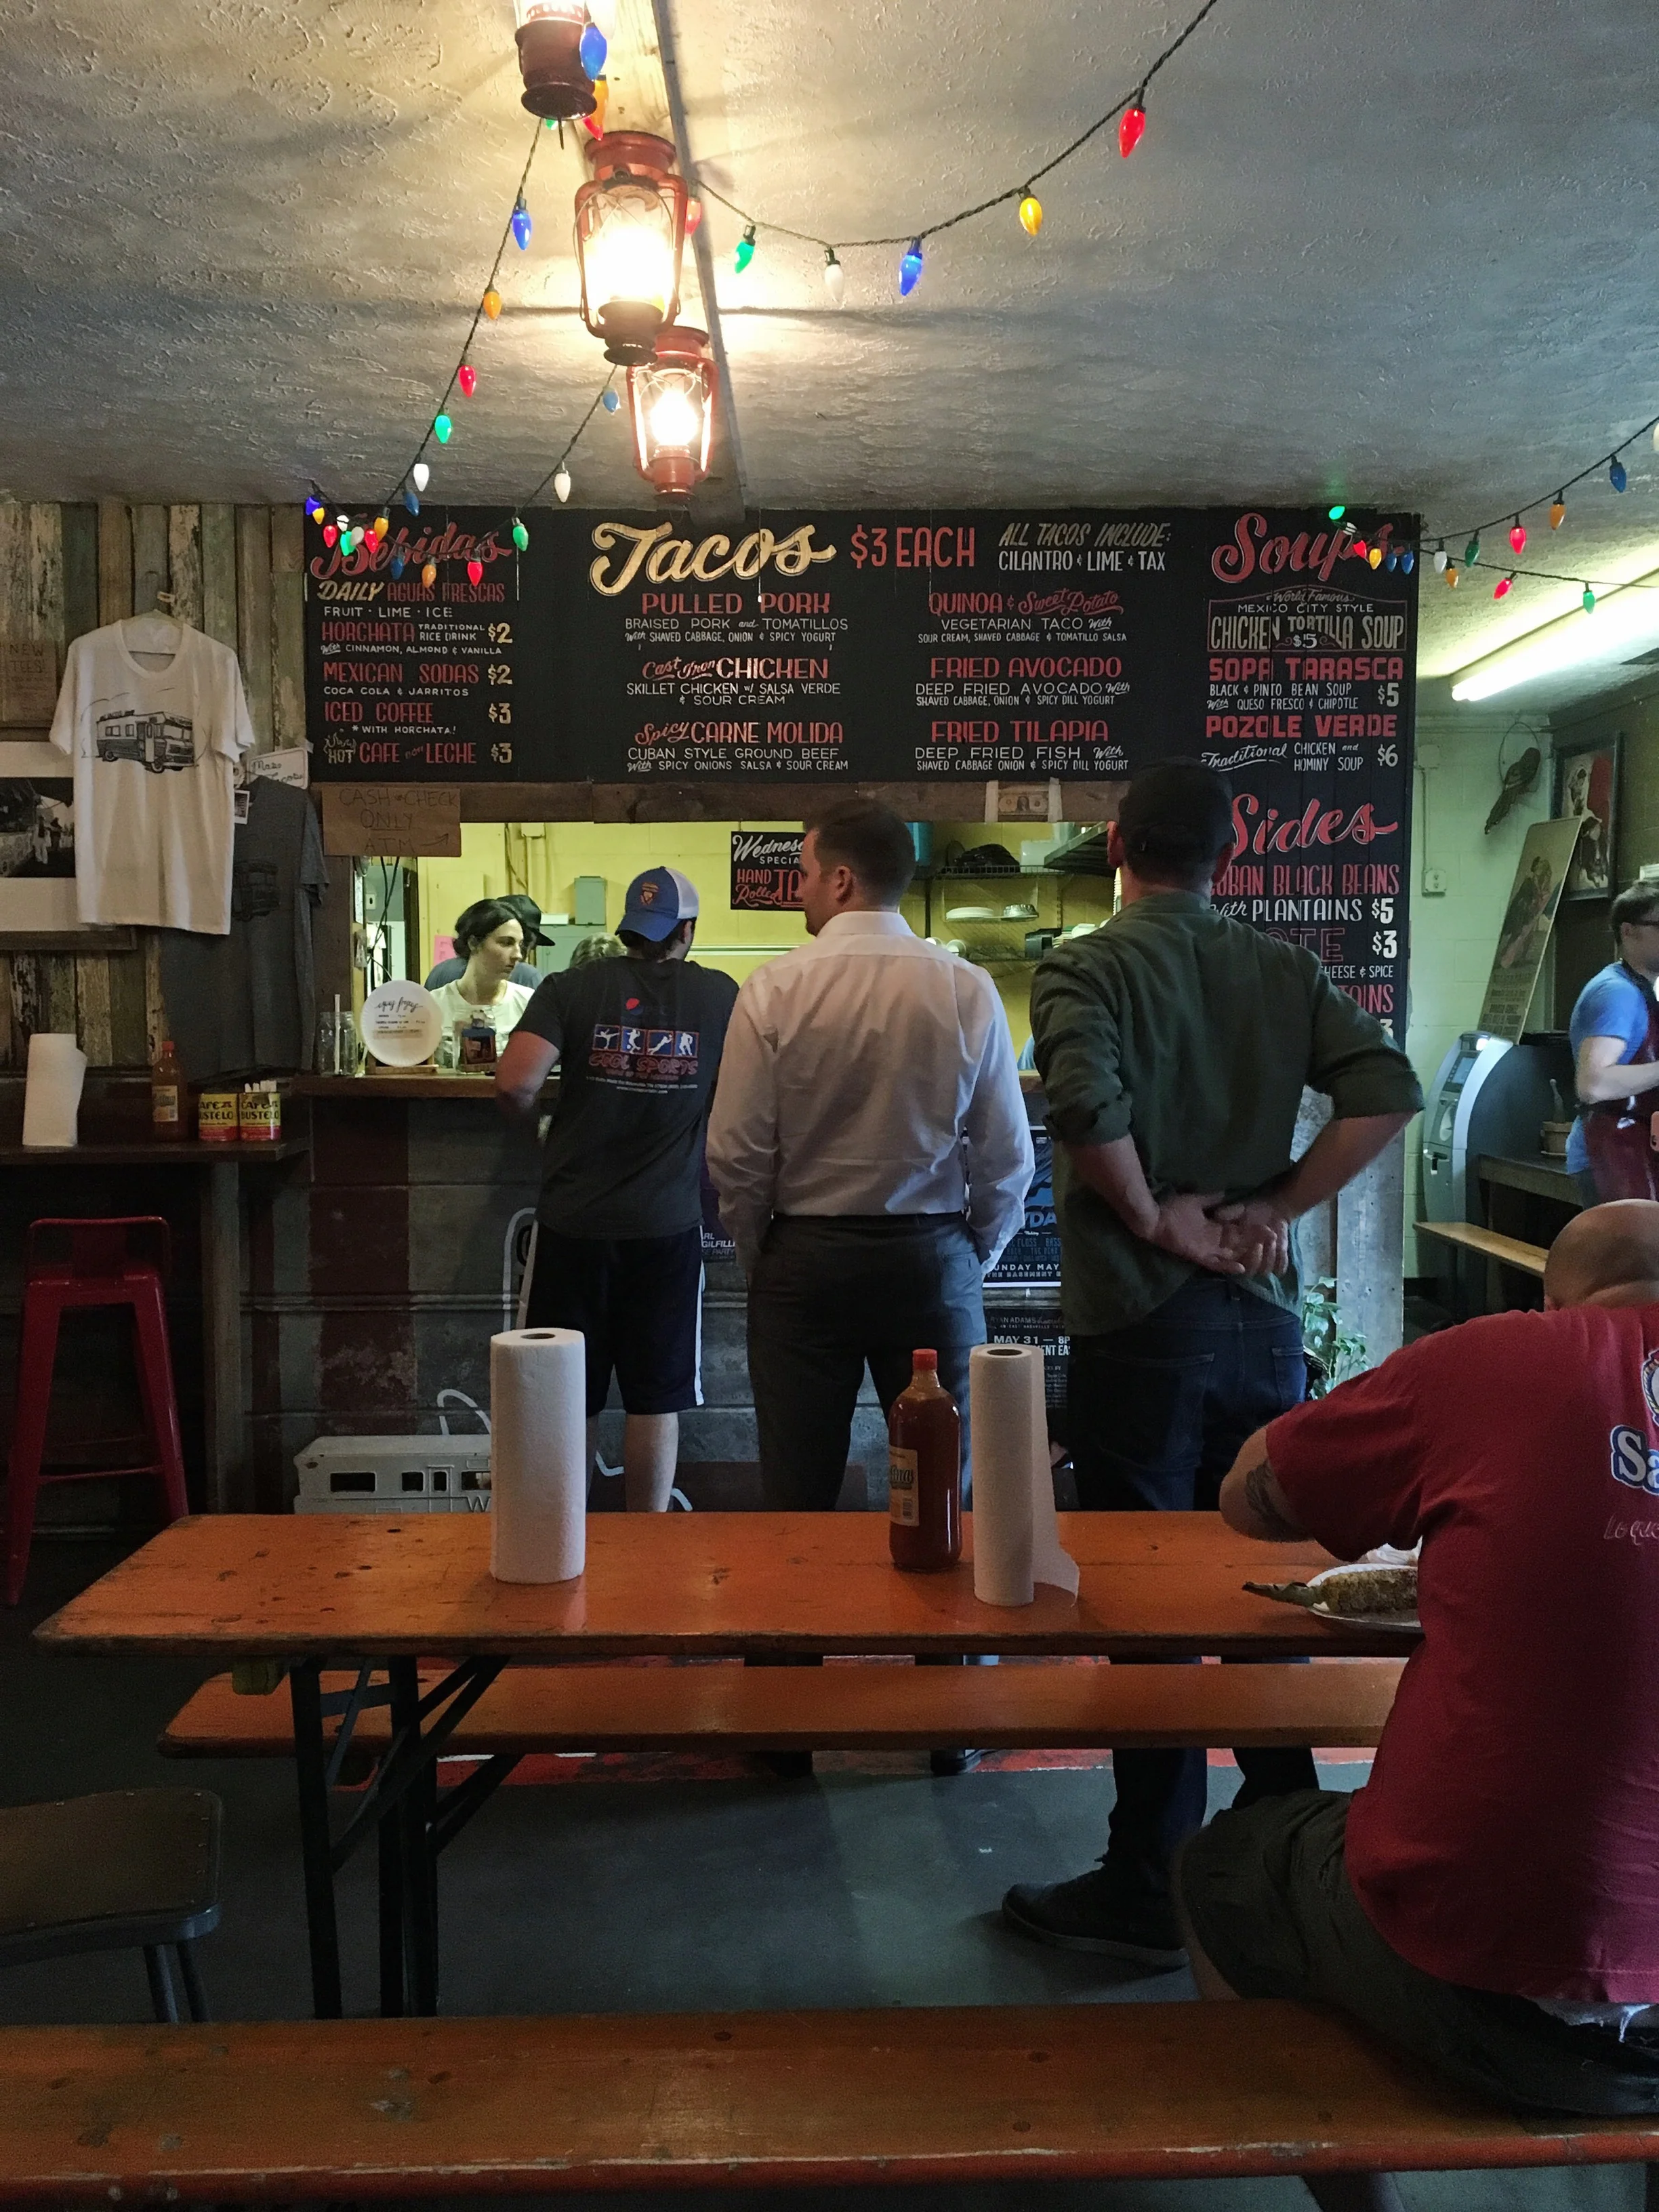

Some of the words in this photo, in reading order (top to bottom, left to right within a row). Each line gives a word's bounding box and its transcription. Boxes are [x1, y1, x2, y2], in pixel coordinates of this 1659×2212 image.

[999, 523, 1029, 547] ALL
[1037, 523, 1091, 547] TACOS
[1094, 523, 1172, 548] INCLUDE:
[851, 524, 887, 569] $3
[896, 527, 975, 567] EACH
[590, 521, 837, 596] Tacos
[998, 550, 1073, 571] CILANTRO
[1087, 550, 1124, 571] LIME
[1138, 552, 1166, 571] TAX
[317, 581, 384, 601] DAILY
[387, 583, 435, 602] AGUAS
[442, 583, 505, 602] FRESCAS
[1307, 588, 1351, 602] Famous
[642, 592, 743, 615] PULLED
[760, 592, 830, 614] PORK
[929, 592, 1003, 616] QUINOA
[1017, 588, 1069, 615] Sweet
[1061, 589, 1124, 615] Potato
[1237, 604, 1288, 613] MEXICO
[1296, 603, 1329, 613] CITY
[1336, 604, 1374, 613] STYLE
[324, 607, 363, 617] FRUIT
[378, 607, 411, 618] LIME
[426, 607, 453, 617] ICE
[321, 621, 415, 642] HORCHATA
[488, 622, 513, 644] $2
[625, 618, 679, 630] BRAISED
[691, 618, 731, 630] PORK
[762, 618, 848, 630] TOMATILLOS
[941, 619, 1031, 630] VEGETARIAN
[1041, 618, 1083, 630] TACO
[1211, 616, 1280, 649] CHICKEN
[1288, 615, 1353, 649] TORTILLA
[1361, 615, 1404, 649] SOUP
[419, 632, 441, 641] RICE
[445, 632, 476, 641] DRINK
[649, 632, 681, 642] SHAVED
[684, 632, 725, 643] CABBAGE,
[729, 633, 753, 642] ONION
[769, 632, 795, 642] SPICY
[801, 632, 836, 642] YOGURT
[918, 633, 939, 643] SOUR
[941, 633, 970, 644] CREAM,
[974, 632, 1002, 642] SHAVED
[1006, 632, 1040, 642] CABBAGE
[1056, 632, 1099, 642] TOMATILLO
[1103, 632, 1127, 642] SALSA
[346, 644, 403, 655] CINNAMON,
[406, 645, 448, 655] ALMOND
[462, 646, 501, 655] VANILLA
[324, 661, 403, 682] MEXICAN
[419, 663, 479, 684] SODAS
[487, 663, 512, 685] $2
[642, 657, 681, 680] Cast
[716, 657, 828, 679] CHICKEN
[930, 657, 1000, 679] FRIED
[1008, 657, 1122, 678] AVOCADO
[1209, 657, 1273, 681] SOPA
[1285, 657, 1404, 680] TARASCA
[324, 686, 354, 696] COCA
[361, 687, 390, 696] COLA
[409, 687, 469, 697] JARRITOS
[626, 684, 675, 695] SKILLET
[680, 684, 739, 695] CHICKEN
[759, 684, 794, 695] SALSA
[802, 683, 841, 694] VERDE
[916, 682, 954, 695] DEEP
[963, 682, 1010, 695] FRIED
[1020, 682, 1102, 695] AVOCADO
[1210, 683, 1239, 696] BLACK
[1253, 683, 1282, 696] PINTO
[1291, 683, 1319, 696] BEAN
[1326, 682, 1352, 696] SOUP
[1377, 682, 1399, 708] $5
[694, 695, 732, 705] SOUR
[738, 695, 785, 705] CREAM
[916, 695, 949, 706] SHAVED
[953, 695, 991, 707] CABBAGE,
[994, 695, 1019, 705] ONION
[1037, 695, 1059, 705] SPICY
[1062, 695, 1080, 705] DILL
[1082, 695, 1115, 705] YOGURT
[1237, 698, 1265, 710] QUESO
[1271, 698, 1305, 710] FRESCO
[1318, 697, 1359, 710] CHIPOTLE
[324, 701, 363, 723] ICED
[376, 701, 434, 724] COFFEE
[488, 702, 512, 724] $3
[362, 726, 387, 734] WITH
[394, 726, 456, 735] HORCHATA!
[635, 722, 691, 745] Spicy
[691, 722, 760, 743] CARNE
[767, 722, 844, 743] MOLIDA
[930, 720, 1000, 743] FRIED
[1010, 720, 1109, 743] TILAPIA
[1206, 716, 1303, 738] POZOLE
[1315, 714, 1397, 737] VERDE
[359, 742, 400, 763] CAFE
[426, 742, 476, 764] LECHE
[491, 743, 512, 764] $3
[628, 747, 675, 760] CUBAN
[684, 748, 726, 760] STYLE
[735, 748, 793, 760] GROUND
[802, 748, 839, 760] BEEF
[915, 747, 959, 760] DEEP
[970, 747, 1023, 760] FRIED
[1036, 746, 1080, 760] FISH
[1201, 743, 1288, 771] Traditional
[1294, 743, 1336, 755] CHICKEN
[1377, 744, 1398, 767] $6
[659, 760, 689, 771] SPICY
[694, 760, 732, 771] ONIONS
[741, 760, 772, 770] SALSA
[786, 760, 813, 771] SOUR
[816, 760, 848, 771] CREAM
[917, 760, 949, 771] SHAVED
[955, 760, 993, 771] CABBAGE
[998, 760, 1025, 771] ONION
[1042, 760, 1070, 771] SPICY
[1073, 760, 1089, 771] DILL
[1094, 760, 1128, 771] YOGURT
[1294, 758, 1329, 771] HOMINY
[1337, 756, 1364, 771] SOUP
[340, 788, 390, 806] CASH
[405, 790, 458, 808] CHECK
[360, 809, 413, 830] ONLY
[1232, 793, 1398, 861] Sides
[365, 838, 416, 854] ATM
[737, 868, 771, 884] HAND
[1273, 864, 1332, 897] BLACK
[1342, 863, 1400, 895] BEANS
[733, 884, 782, 907] Rolled
[1252, 899, 1362, 922] PLANTAINS
[1371, 897, 1394, 924] $5
[1372, 930, 1397, 959] $3
[1320, 965, 1355, 979] HEESE
[1369, 965, 1393, 978] SPICE
[637, 1057, 698, 1075] SPORTS
[994, 1335, 1020, 1343] MAY
